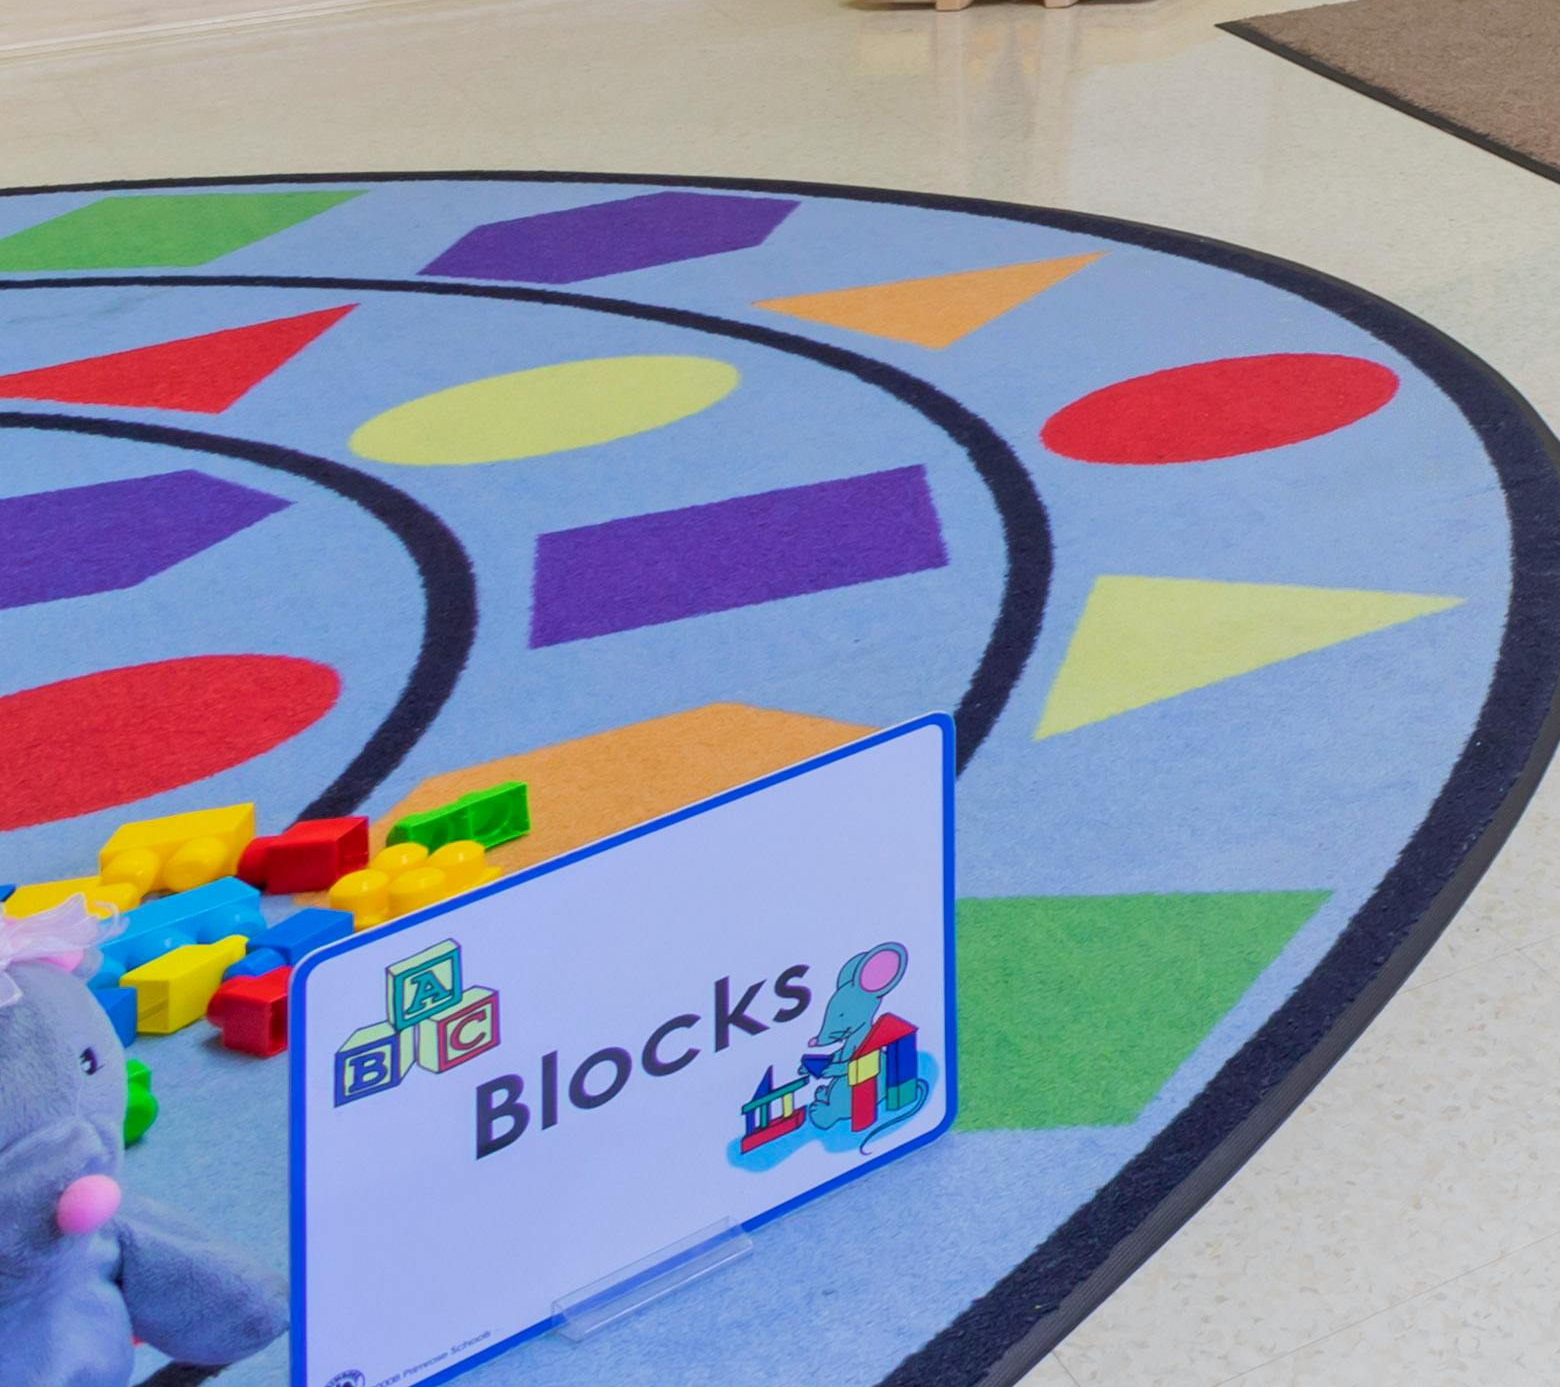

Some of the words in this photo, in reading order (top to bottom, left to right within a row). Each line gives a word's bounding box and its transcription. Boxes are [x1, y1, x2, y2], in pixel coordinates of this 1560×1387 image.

[404, 970, 454, 1015] A
[450, 1008, 487, 1051] C
[347, 1051, 388, 1094] B
[476, 962, 811, 1160] Blocks
